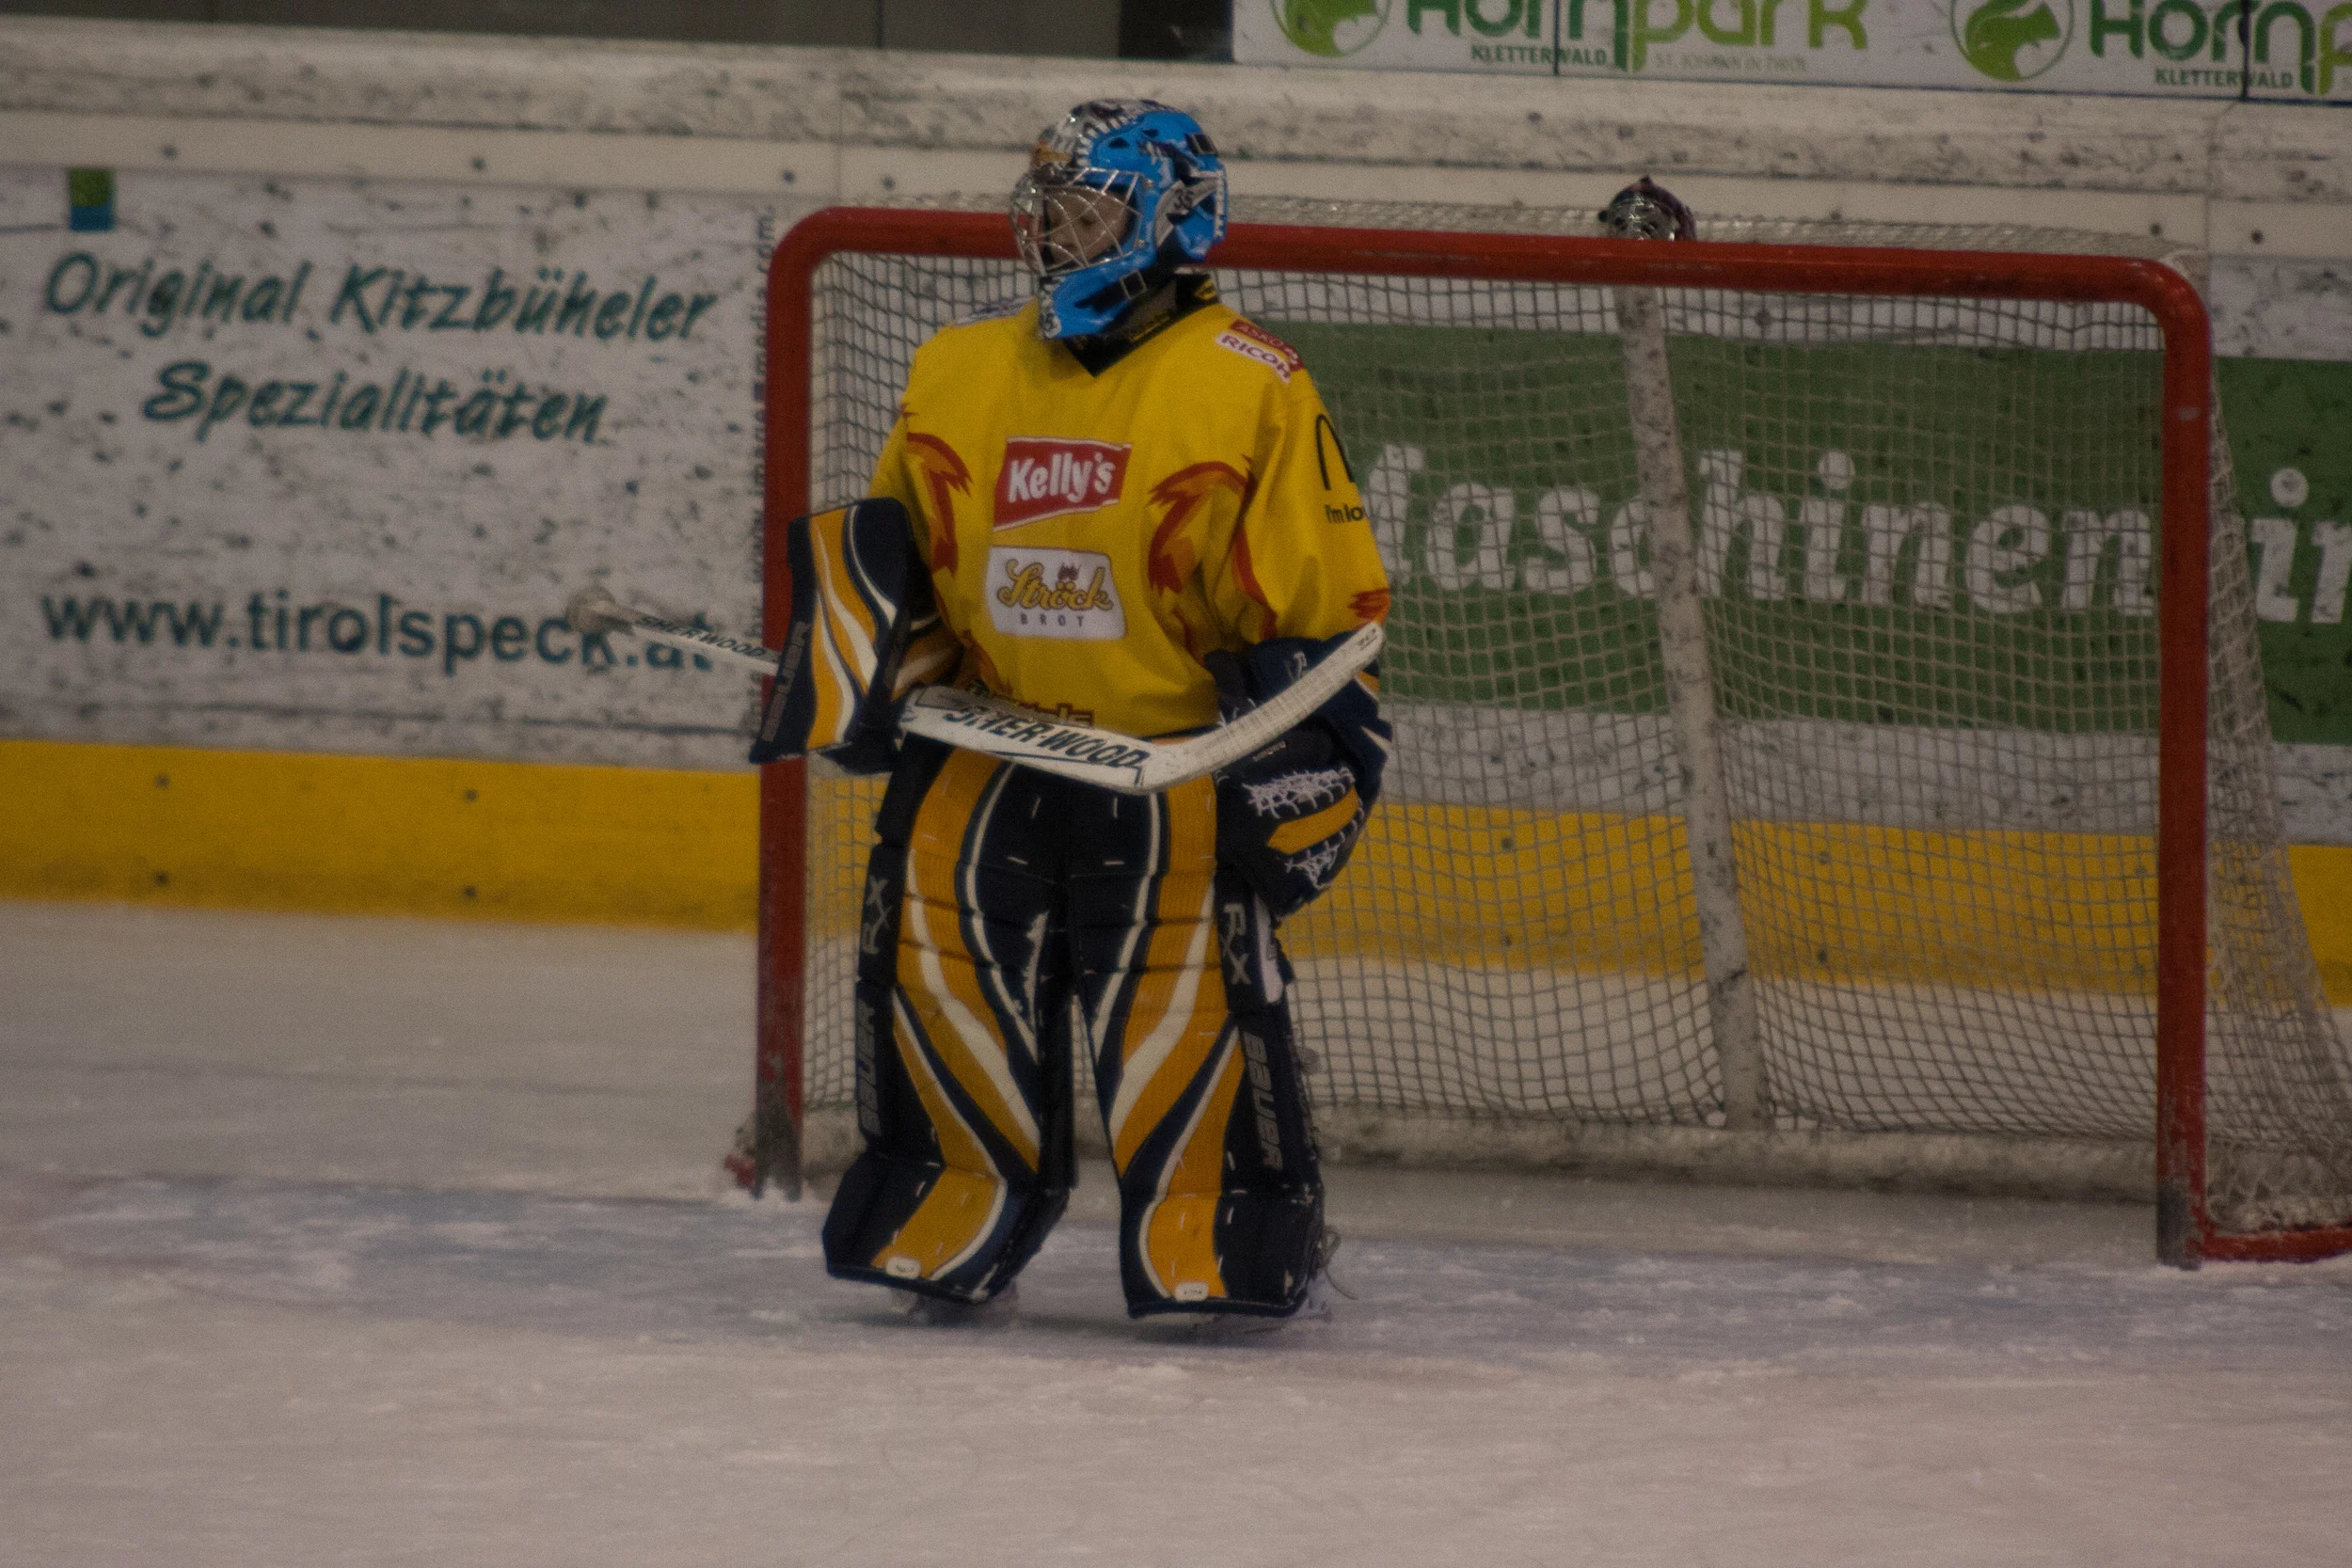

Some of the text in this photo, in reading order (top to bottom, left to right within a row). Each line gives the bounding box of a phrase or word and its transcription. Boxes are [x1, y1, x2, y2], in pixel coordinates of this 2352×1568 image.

[1471, 44, 1607, 67] KLETTERWALD
[45, 252, 717, 341] Original Kitzbüheler
[1222, 334, 1291, 378] RICOH
[143, 360, 610, 444] Spezialitäten
[1007, 451, 1116, 504] Kelly's
[996, 559, 1114, 610] Ströck
[40, 591, 713, 673] www.tirolspeck.at
[1021, 612, 1085, 628] BROT
